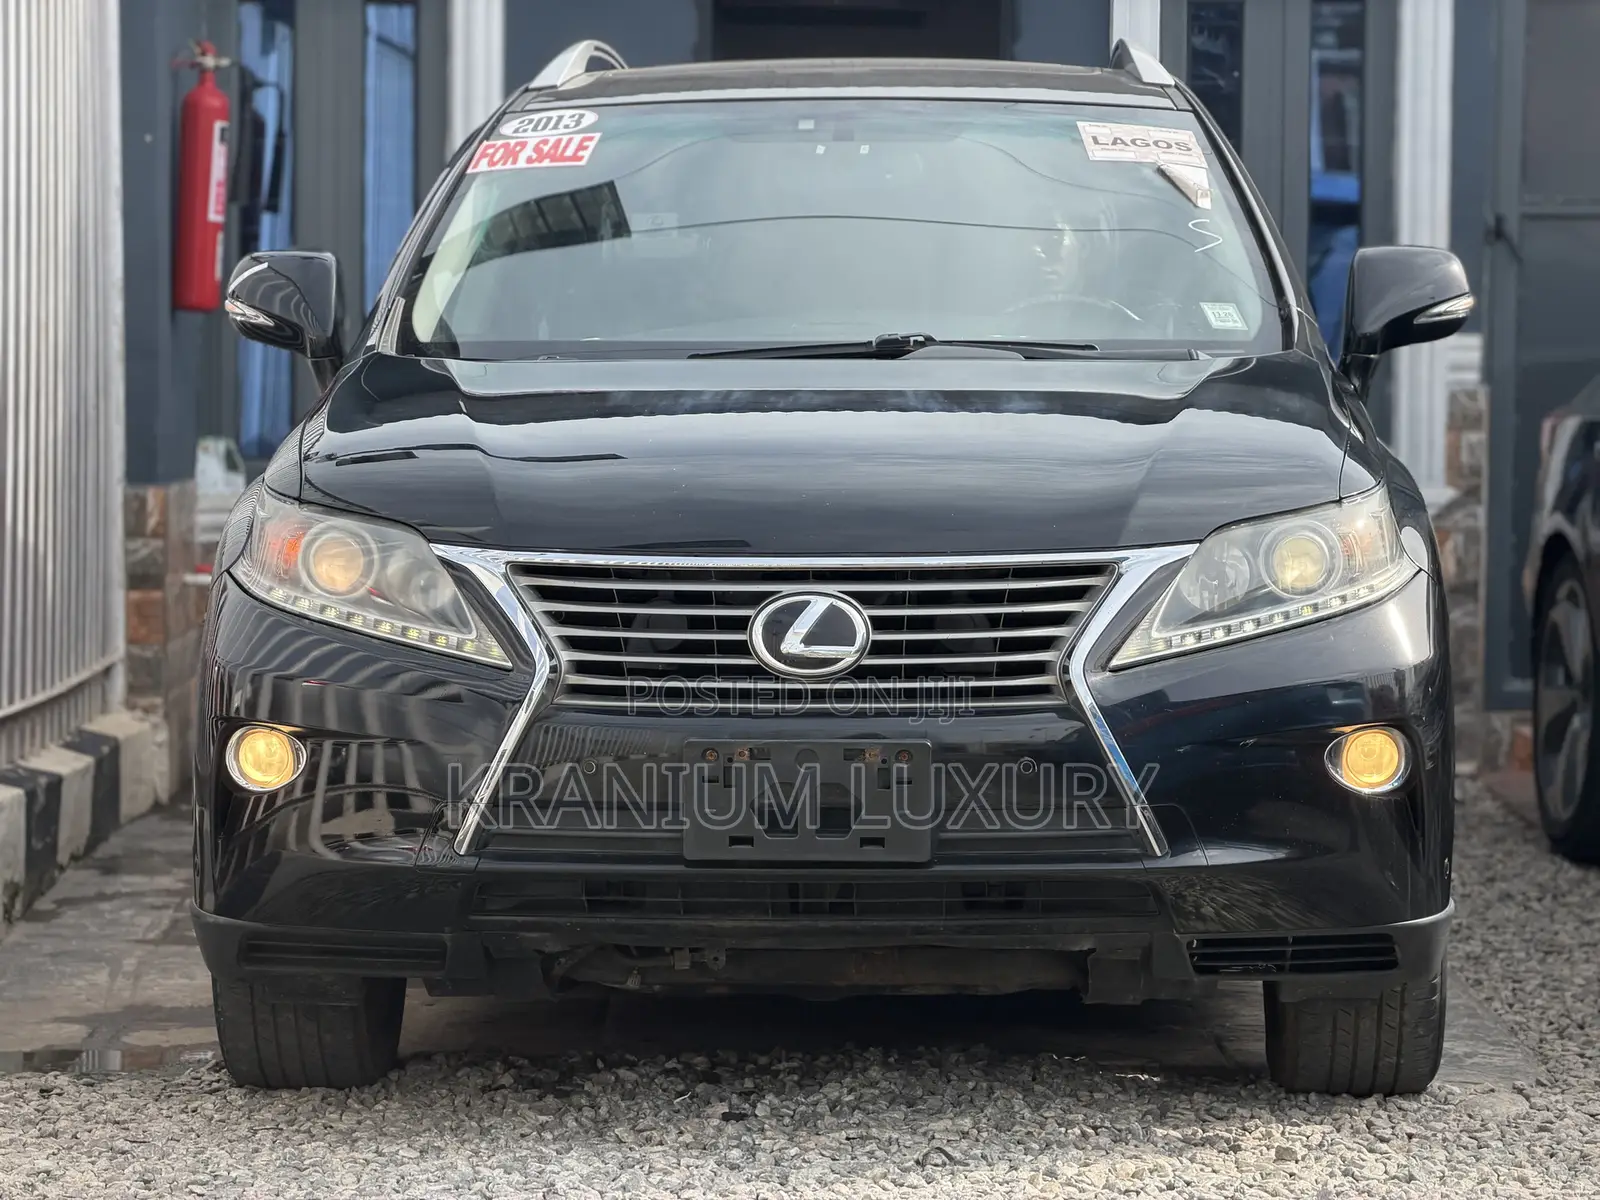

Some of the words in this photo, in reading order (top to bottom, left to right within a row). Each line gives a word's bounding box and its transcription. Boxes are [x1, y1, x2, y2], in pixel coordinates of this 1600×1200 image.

[512, 113, 586, 135] 2013
[471, 140, 528, 169] FOR
[526, 136, 596, 165] SALE
[1091, 135, 1193, 152] LAGOS
